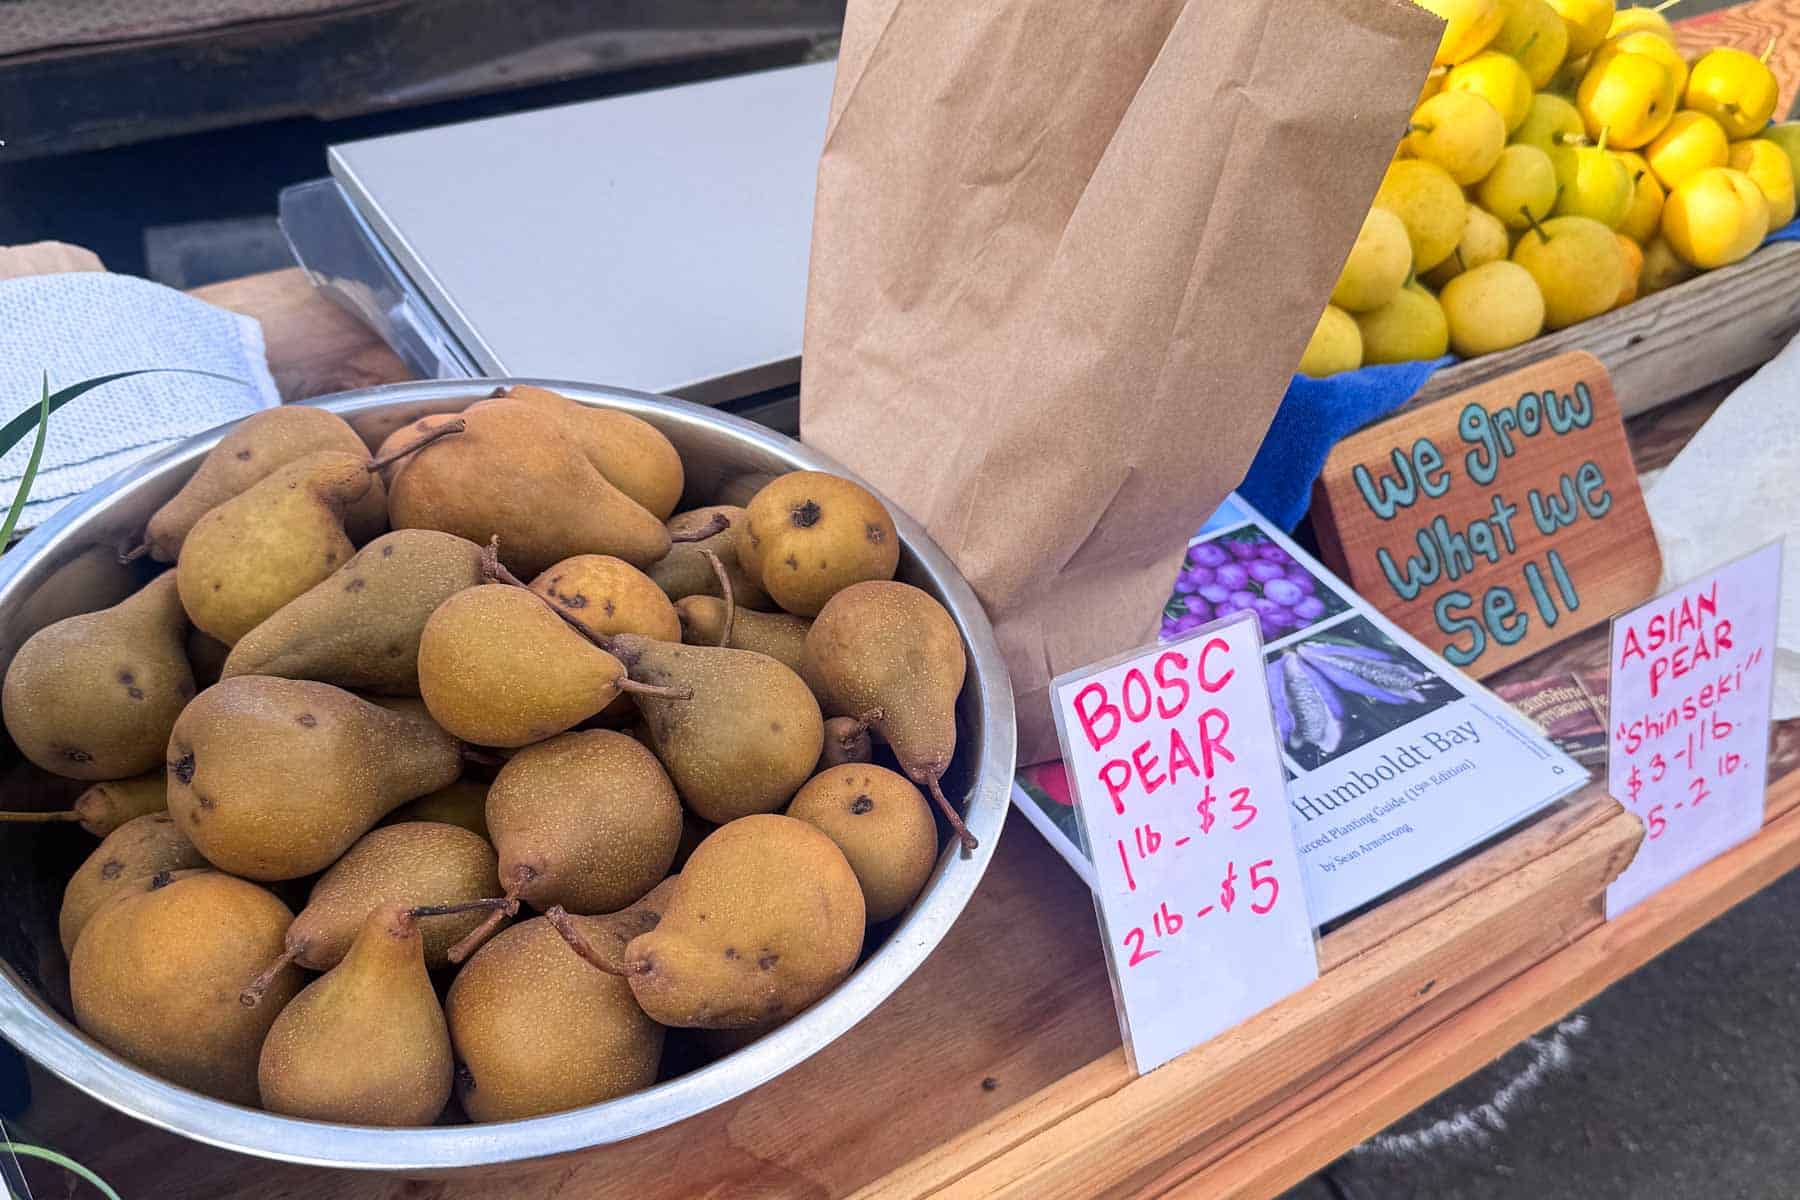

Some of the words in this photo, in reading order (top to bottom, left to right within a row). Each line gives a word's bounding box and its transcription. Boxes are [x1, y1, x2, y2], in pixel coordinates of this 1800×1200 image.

[1459, 381, 1594, 486] grow
[1621, 581, 1718, 670] ASIAN
[1650, 619, 1733, 698] PEAR
[1073, 638, 1235, 752] BOSC
[1098, 708, 1236, 815] PEAR
[1291, 747, 1432, 822] Humboldt
[1423, 719, 1481, 753] Bay
[1329, 812, 1377, 842] Planting
[1374, 796, 1406, 818] Guide
[1429, 758, 1477, 787] Edition)
[1358, 822, 1414, 853] Armstrong
